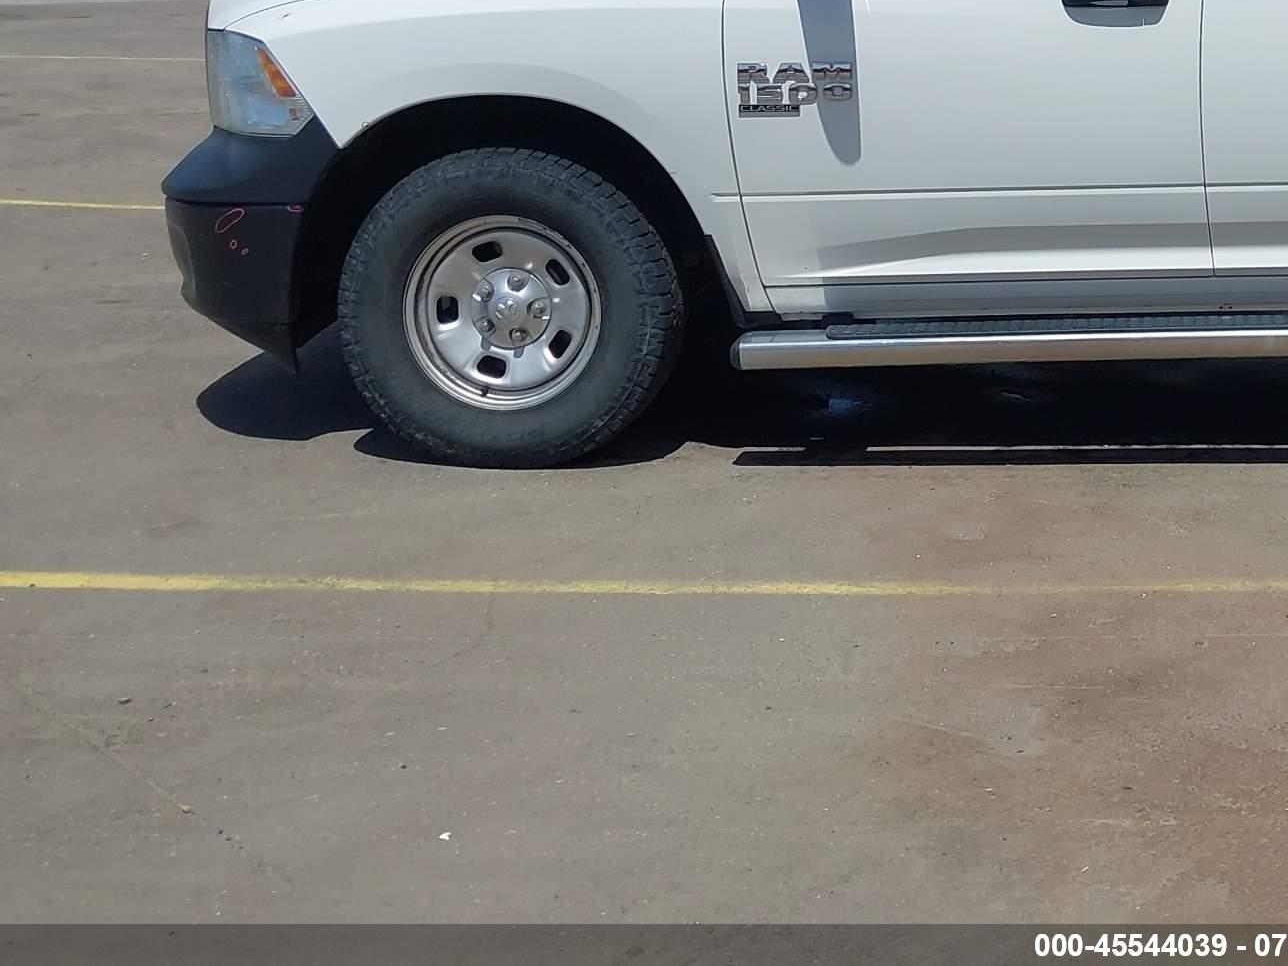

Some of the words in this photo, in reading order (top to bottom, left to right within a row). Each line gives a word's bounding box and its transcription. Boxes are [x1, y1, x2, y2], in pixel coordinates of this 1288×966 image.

[736, 62, 853, 84] RAM
[737, 82, 853, 106] 1500
[740, 105, 800, 113] CLASSIC
